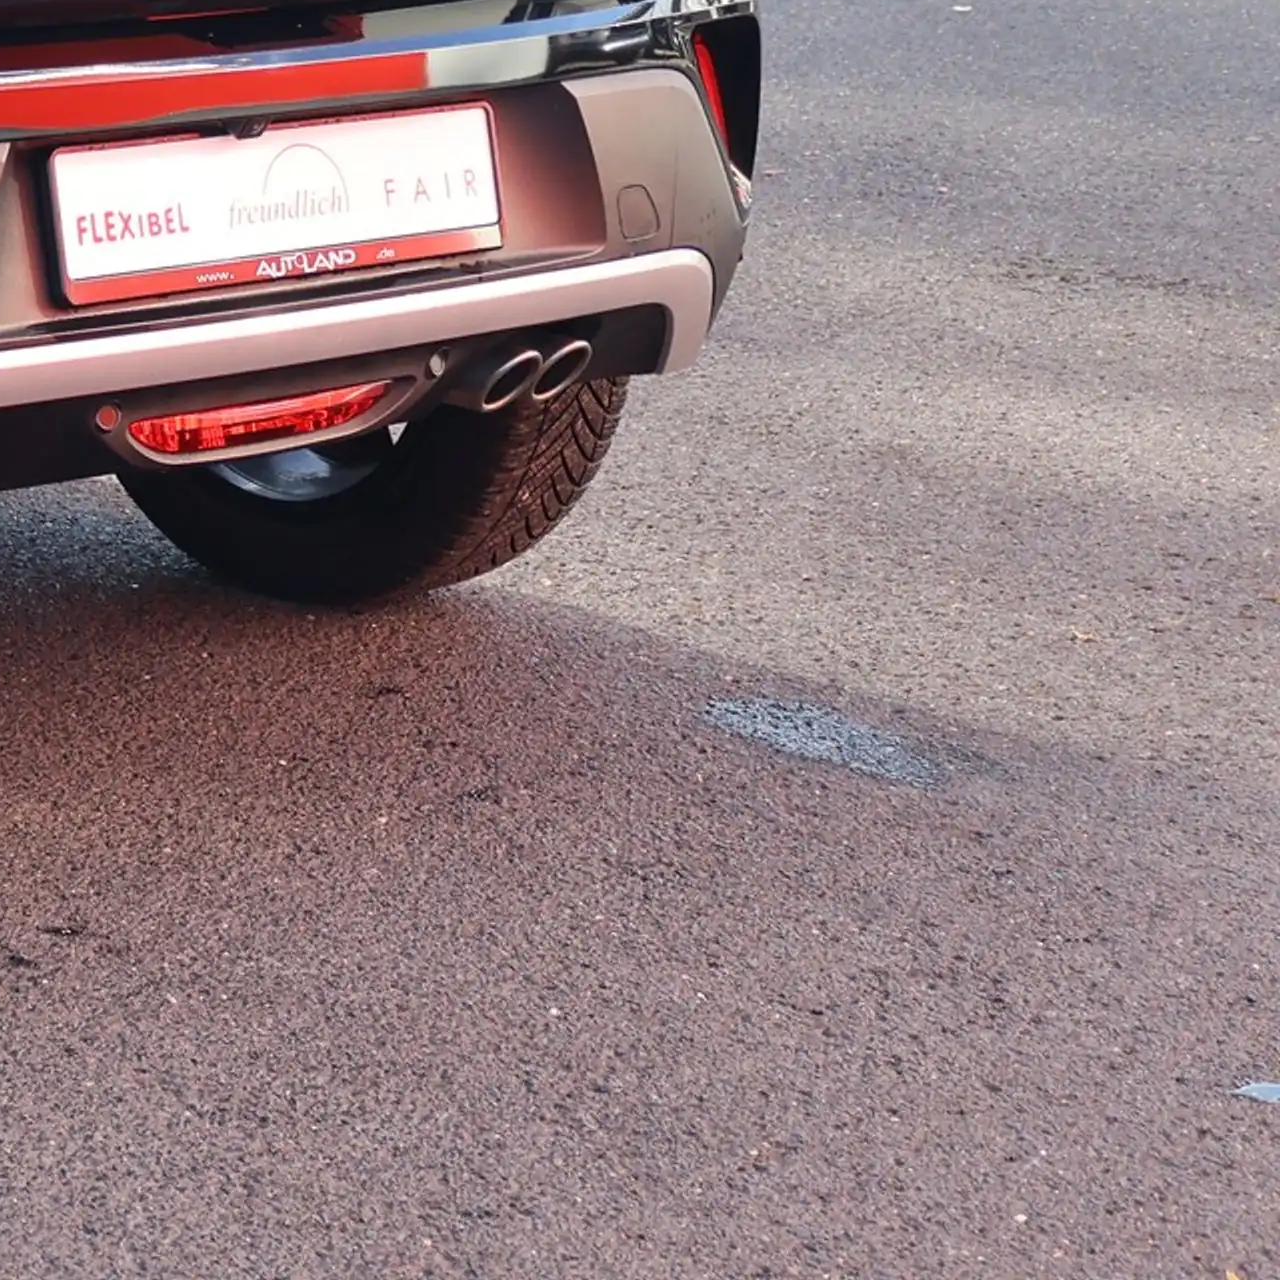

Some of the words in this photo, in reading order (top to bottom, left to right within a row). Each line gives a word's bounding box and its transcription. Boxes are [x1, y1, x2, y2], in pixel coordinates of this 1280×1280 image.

[75, 202, 191, 247] FLEXIBEL
[228, 185, 344, 230] freundlich
[383, 168, 478, 208] FAIR
[195, 271, 236, 285] www.
[256, 248, 357, 279] AUTOLAND
[375, 246, 396, 260] .de
